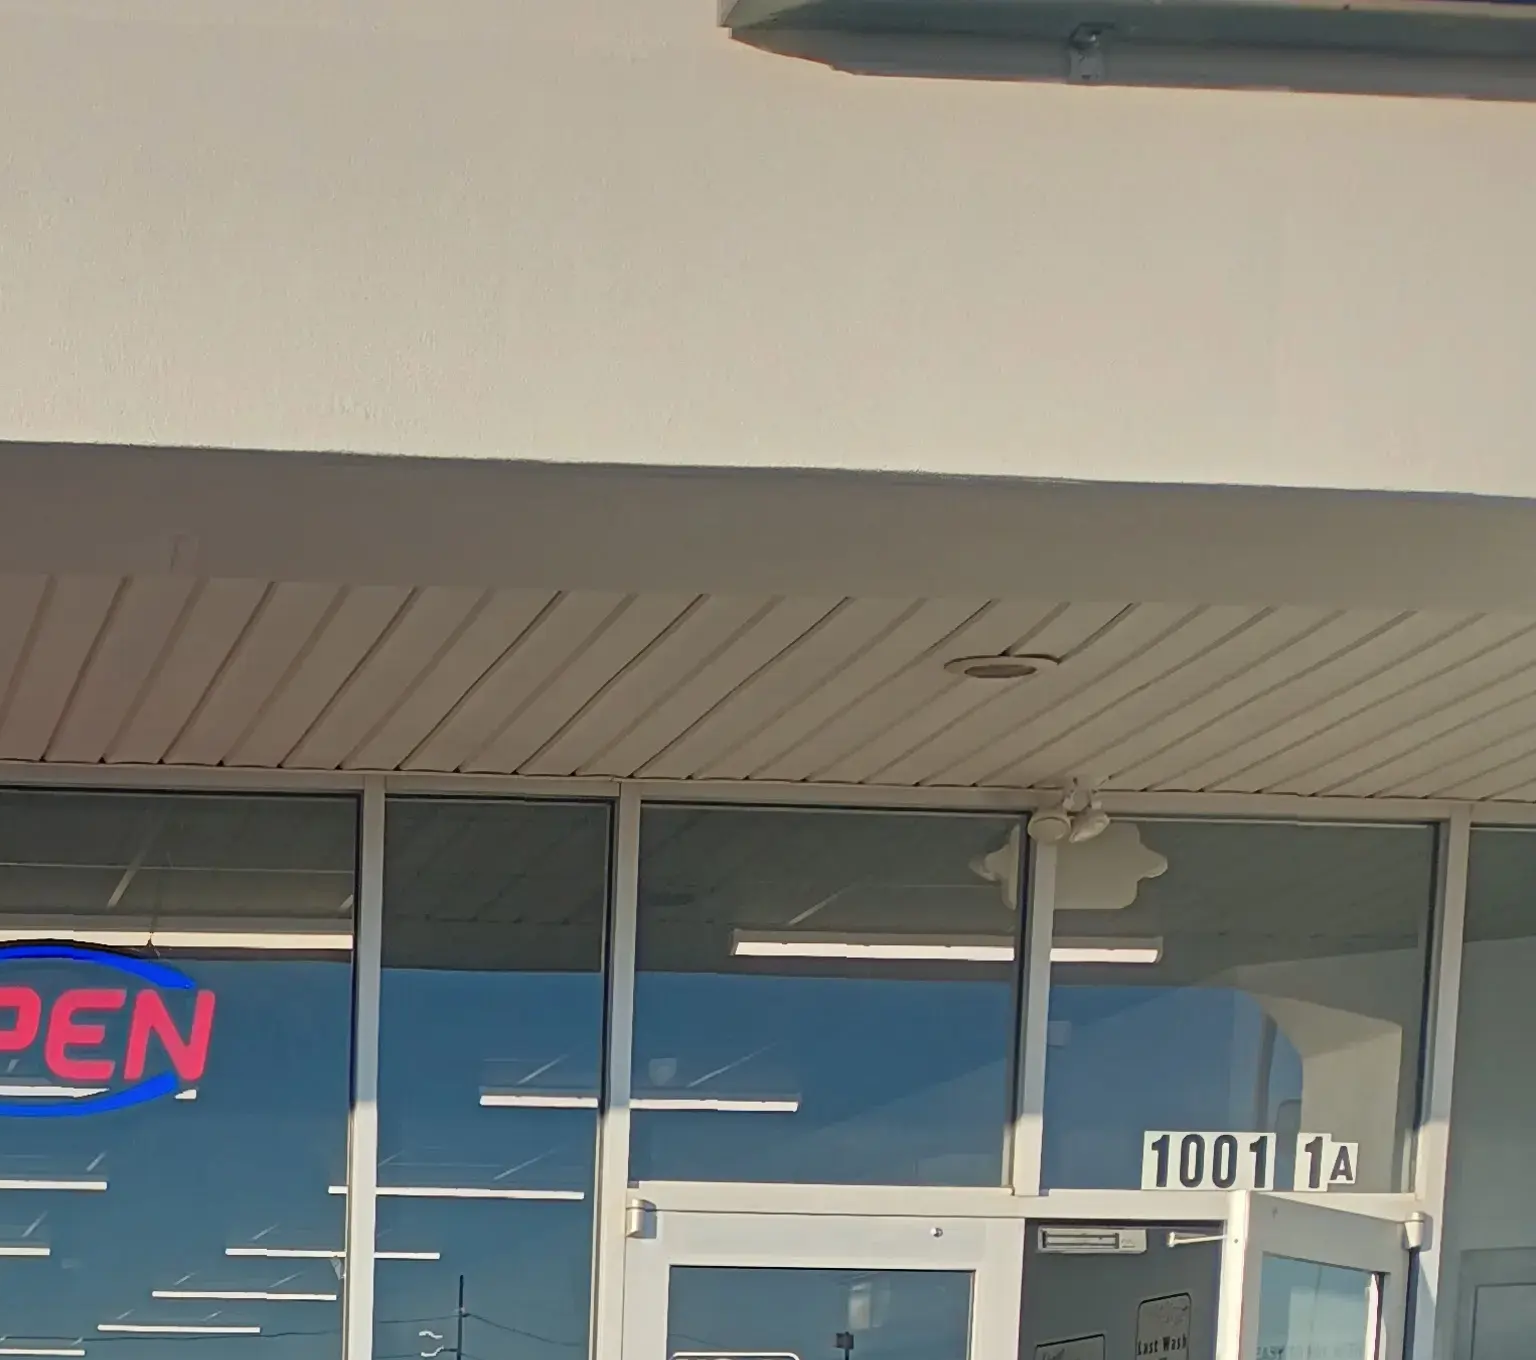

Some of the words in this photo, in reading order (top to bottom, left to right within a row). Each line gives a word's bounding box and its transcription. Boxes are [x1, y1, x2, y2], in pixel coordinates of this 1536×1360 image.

[1151, 1134, 1268, 1188] 1001
[1137, 1339, 1159, 1356] Last
[1162, 1333, 1187, 1352] Wash
